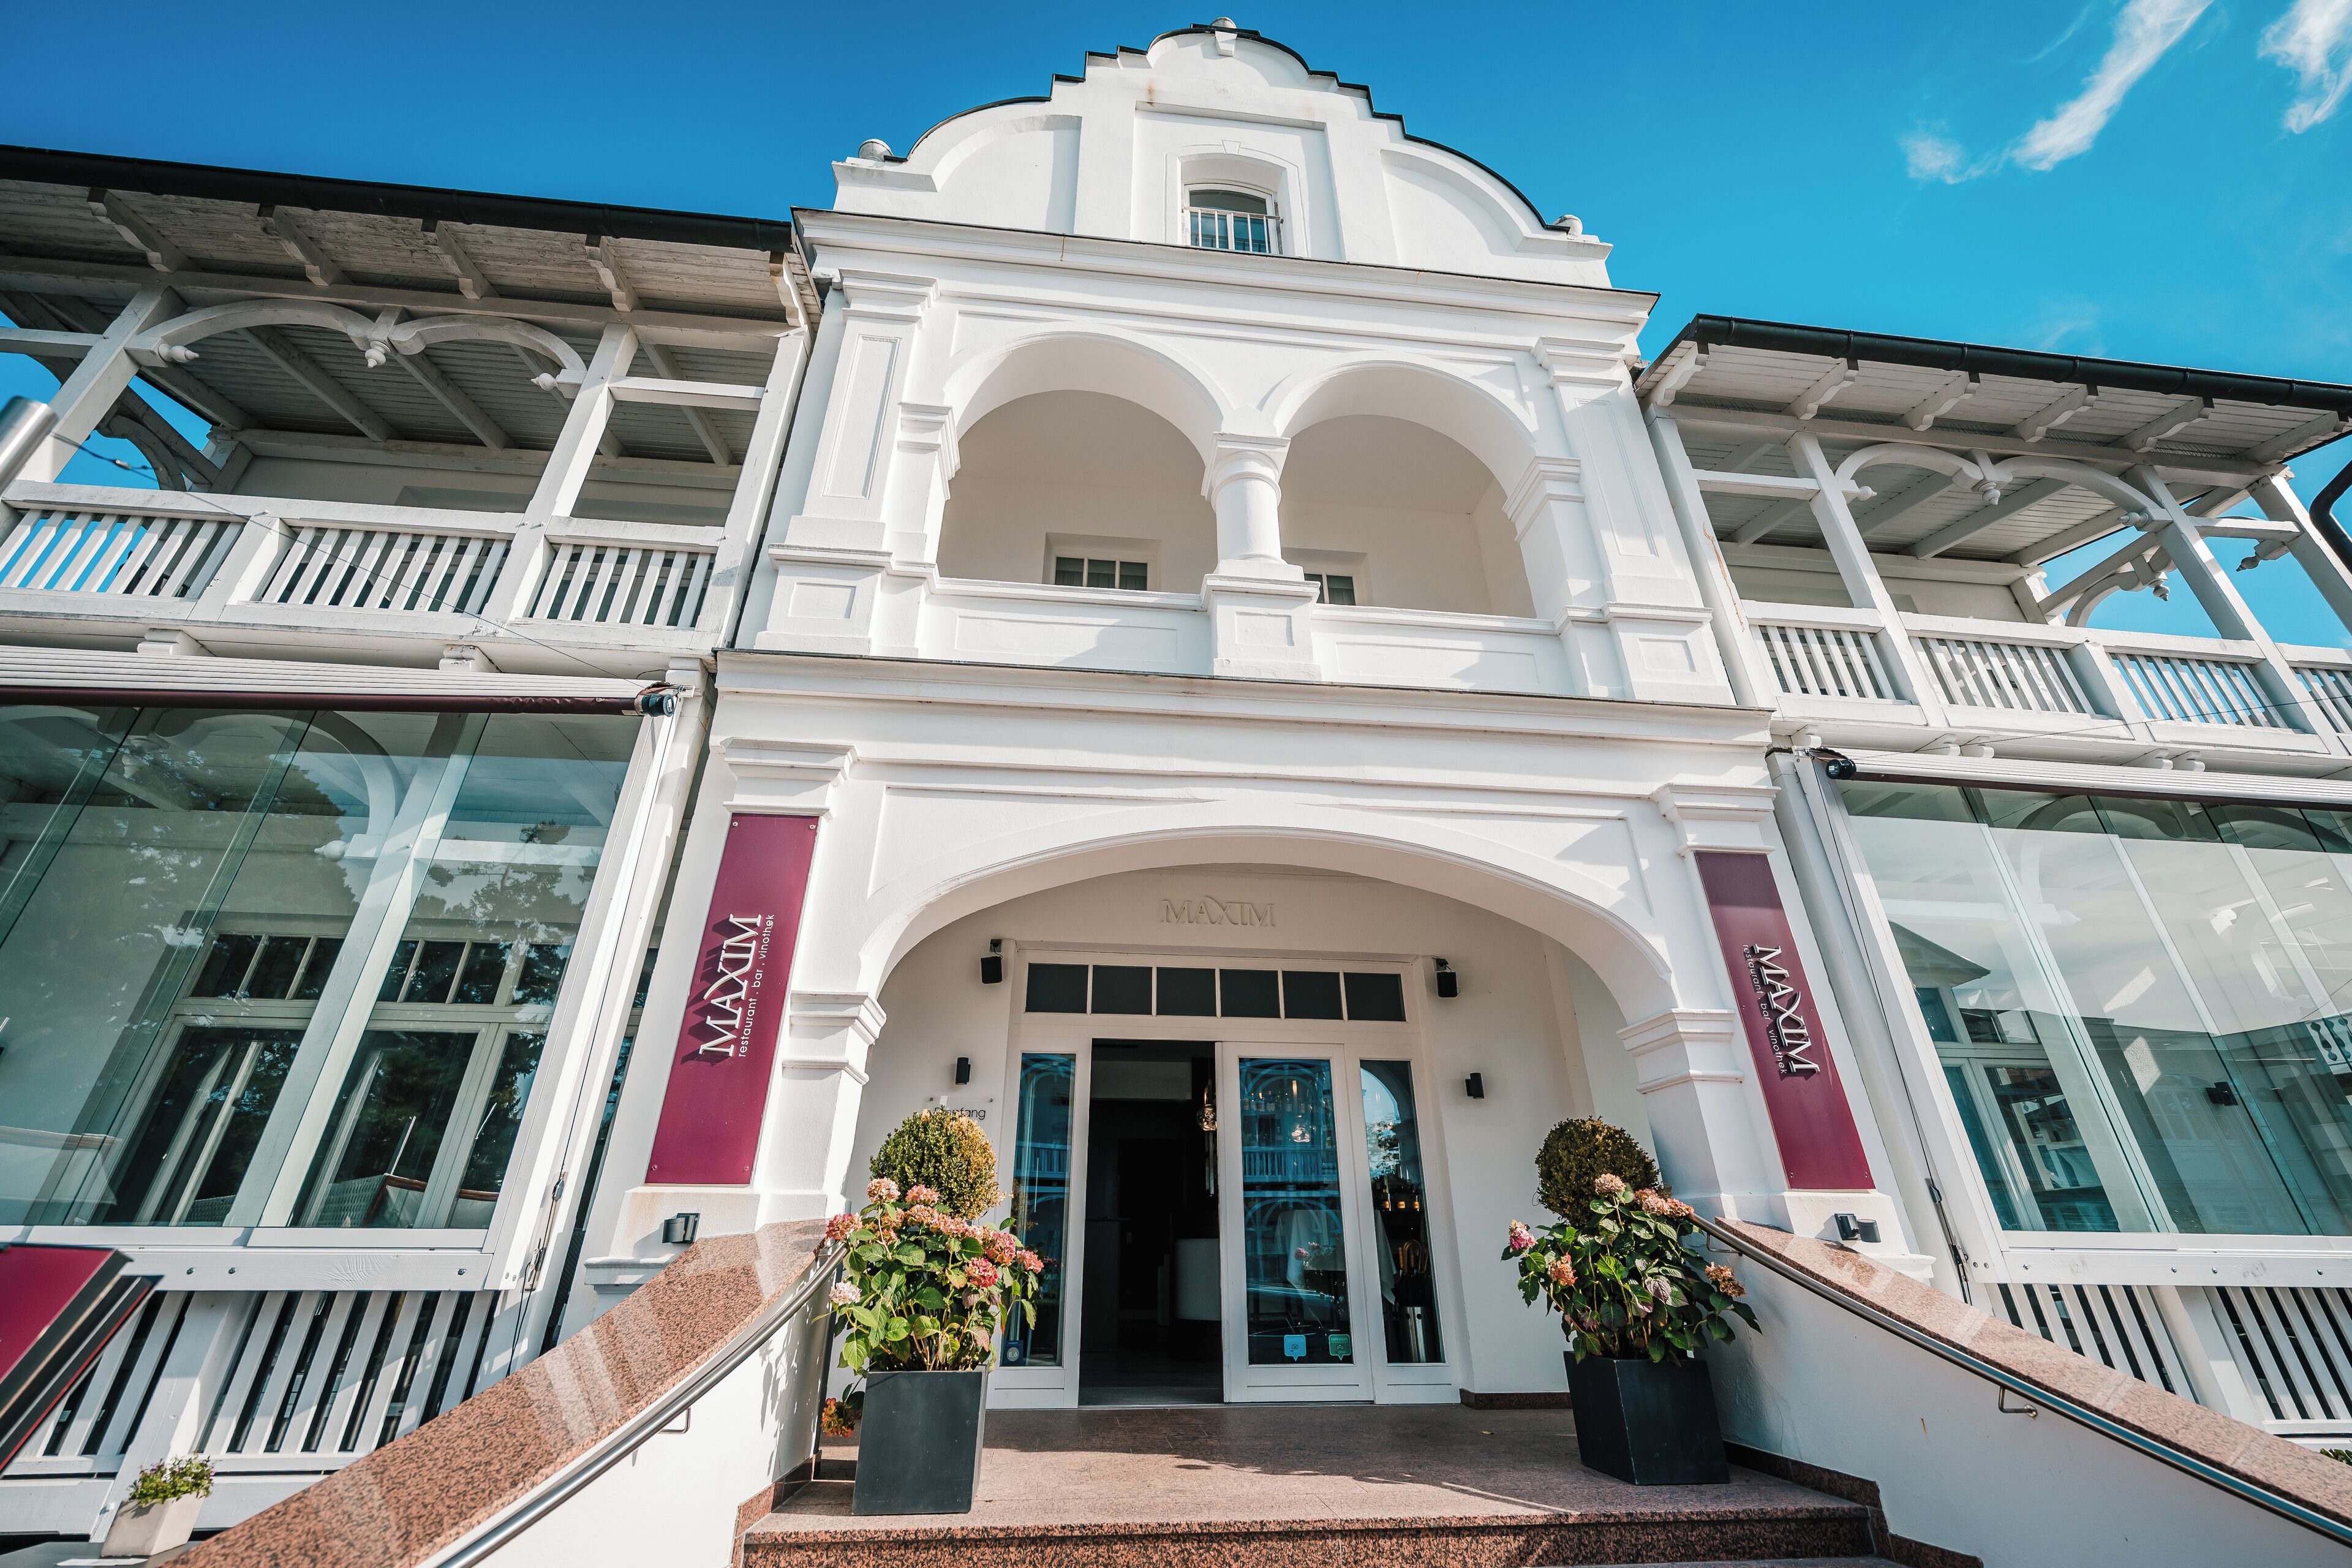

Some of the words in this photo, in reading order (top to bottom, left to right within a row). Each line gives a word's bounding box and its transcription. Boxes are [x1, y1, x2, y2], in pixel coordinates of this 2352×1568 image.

[1161, 895, 1276, 927] MAXIM
[699, 913, 762, 1057] MAXIM
[738, 998, 758, 1057] restaurant
[752, 967, 763, 989] bar
[759, 914, 775, 959] vinothek
[1743, 944, 1764, 994] restaurant
[1760, 1003, 1771, 1020] bar
[1769, 1030, 1787, 1074] vinothek
[1753, 944, 1820, 1072] MAXIM
[935, 1107, 986, 1120] fang
